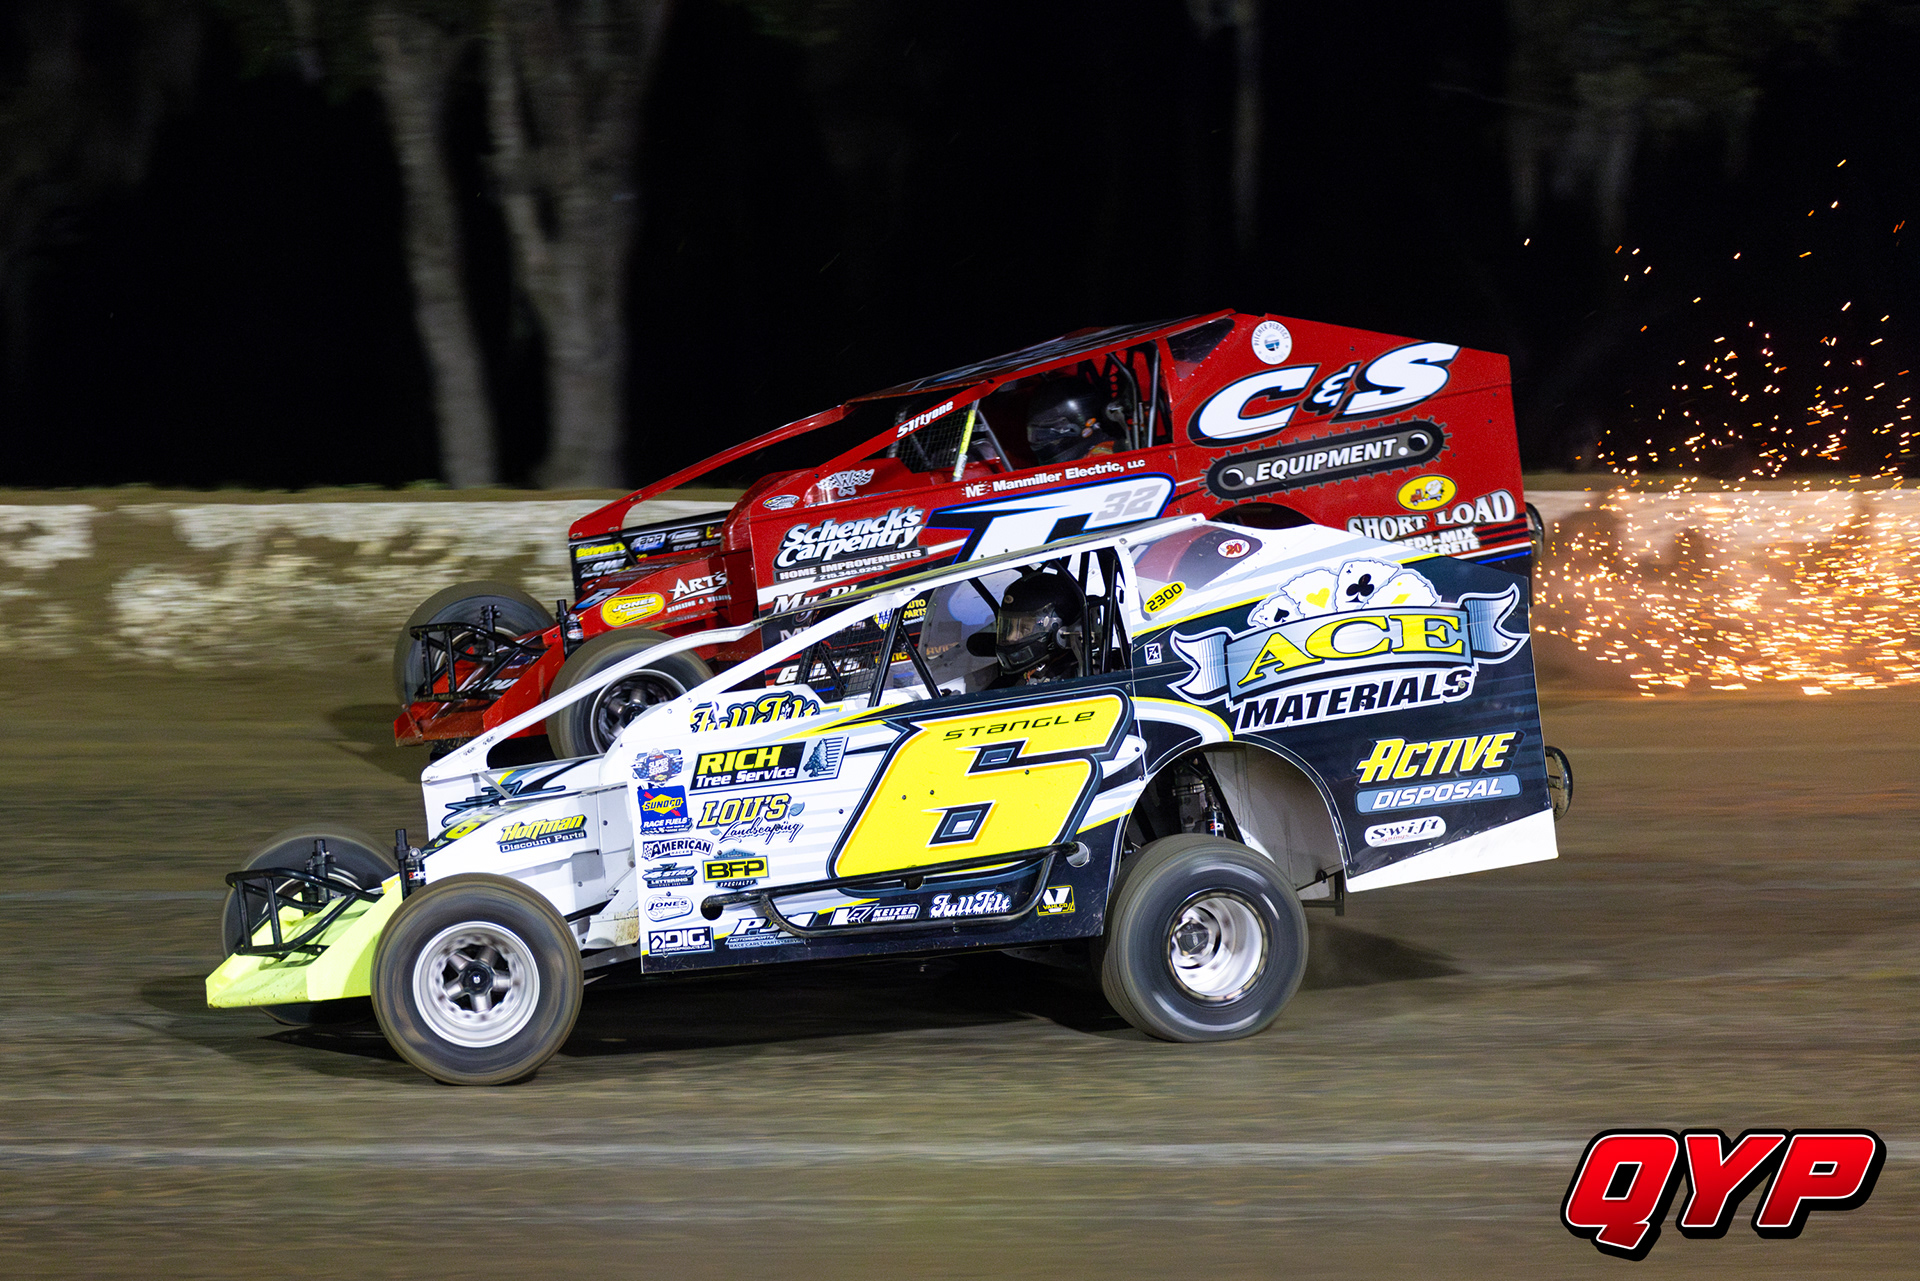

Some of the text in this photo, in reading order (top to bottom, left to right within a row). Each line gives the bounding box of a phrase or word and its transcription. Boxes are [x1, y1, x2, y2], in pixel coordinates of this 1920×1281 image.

[1253, 322, 1290, 346] PITCHER PERFECT
[1187, 340, 1461, 447] C&S
[1255, 438, 1398, 483] EQUIPMENT
[992, 471, 1062, 493] Manmiller
[1065, 461, 1125, 480] Electric,
[1127, 459, 1146, 470] LLC
[781, 506, 924, 547] Schenck's
[1347, 489, 1517, 543] SHORT LOAD
[775, 524, 924, 568] Carpentry
[779, 549, 921, 581] HOME IMPROVEMENTS
[667, 571, 728, 600] ART'S
[1146, 583, 1183, 612] 2300
[612, 597, 656, 613] JONES
[1237, 614, 1465, 687] ACE
[1240, 670, 1472, 730] MATERIALS
[697, 746, 783, 775] RICH
[1356, 732, 1517, 784] ACTIVE
[696, 767, 796, 788] Tree Service
[830, 690, 1130, 880] 6
[644, 799, 682, 810] SUNOCO
[1371, 778, 1502, 810] DISPOSAL
[643, 817, 688, 828] RACE FUELS
[696, 793, 792, 829] LOU'S
[500, 814, 585, 842] Hoffman
[501, 831, 585, 853] Discount Parts
[719, 816, 804, 845] Landscaping
[650, 840, 711, 858] AMERICAN
[707, 860, 764, 879] BFP
[648, 900, 687, 911] JONES
[874, 906, 917, 917] KEIZER
